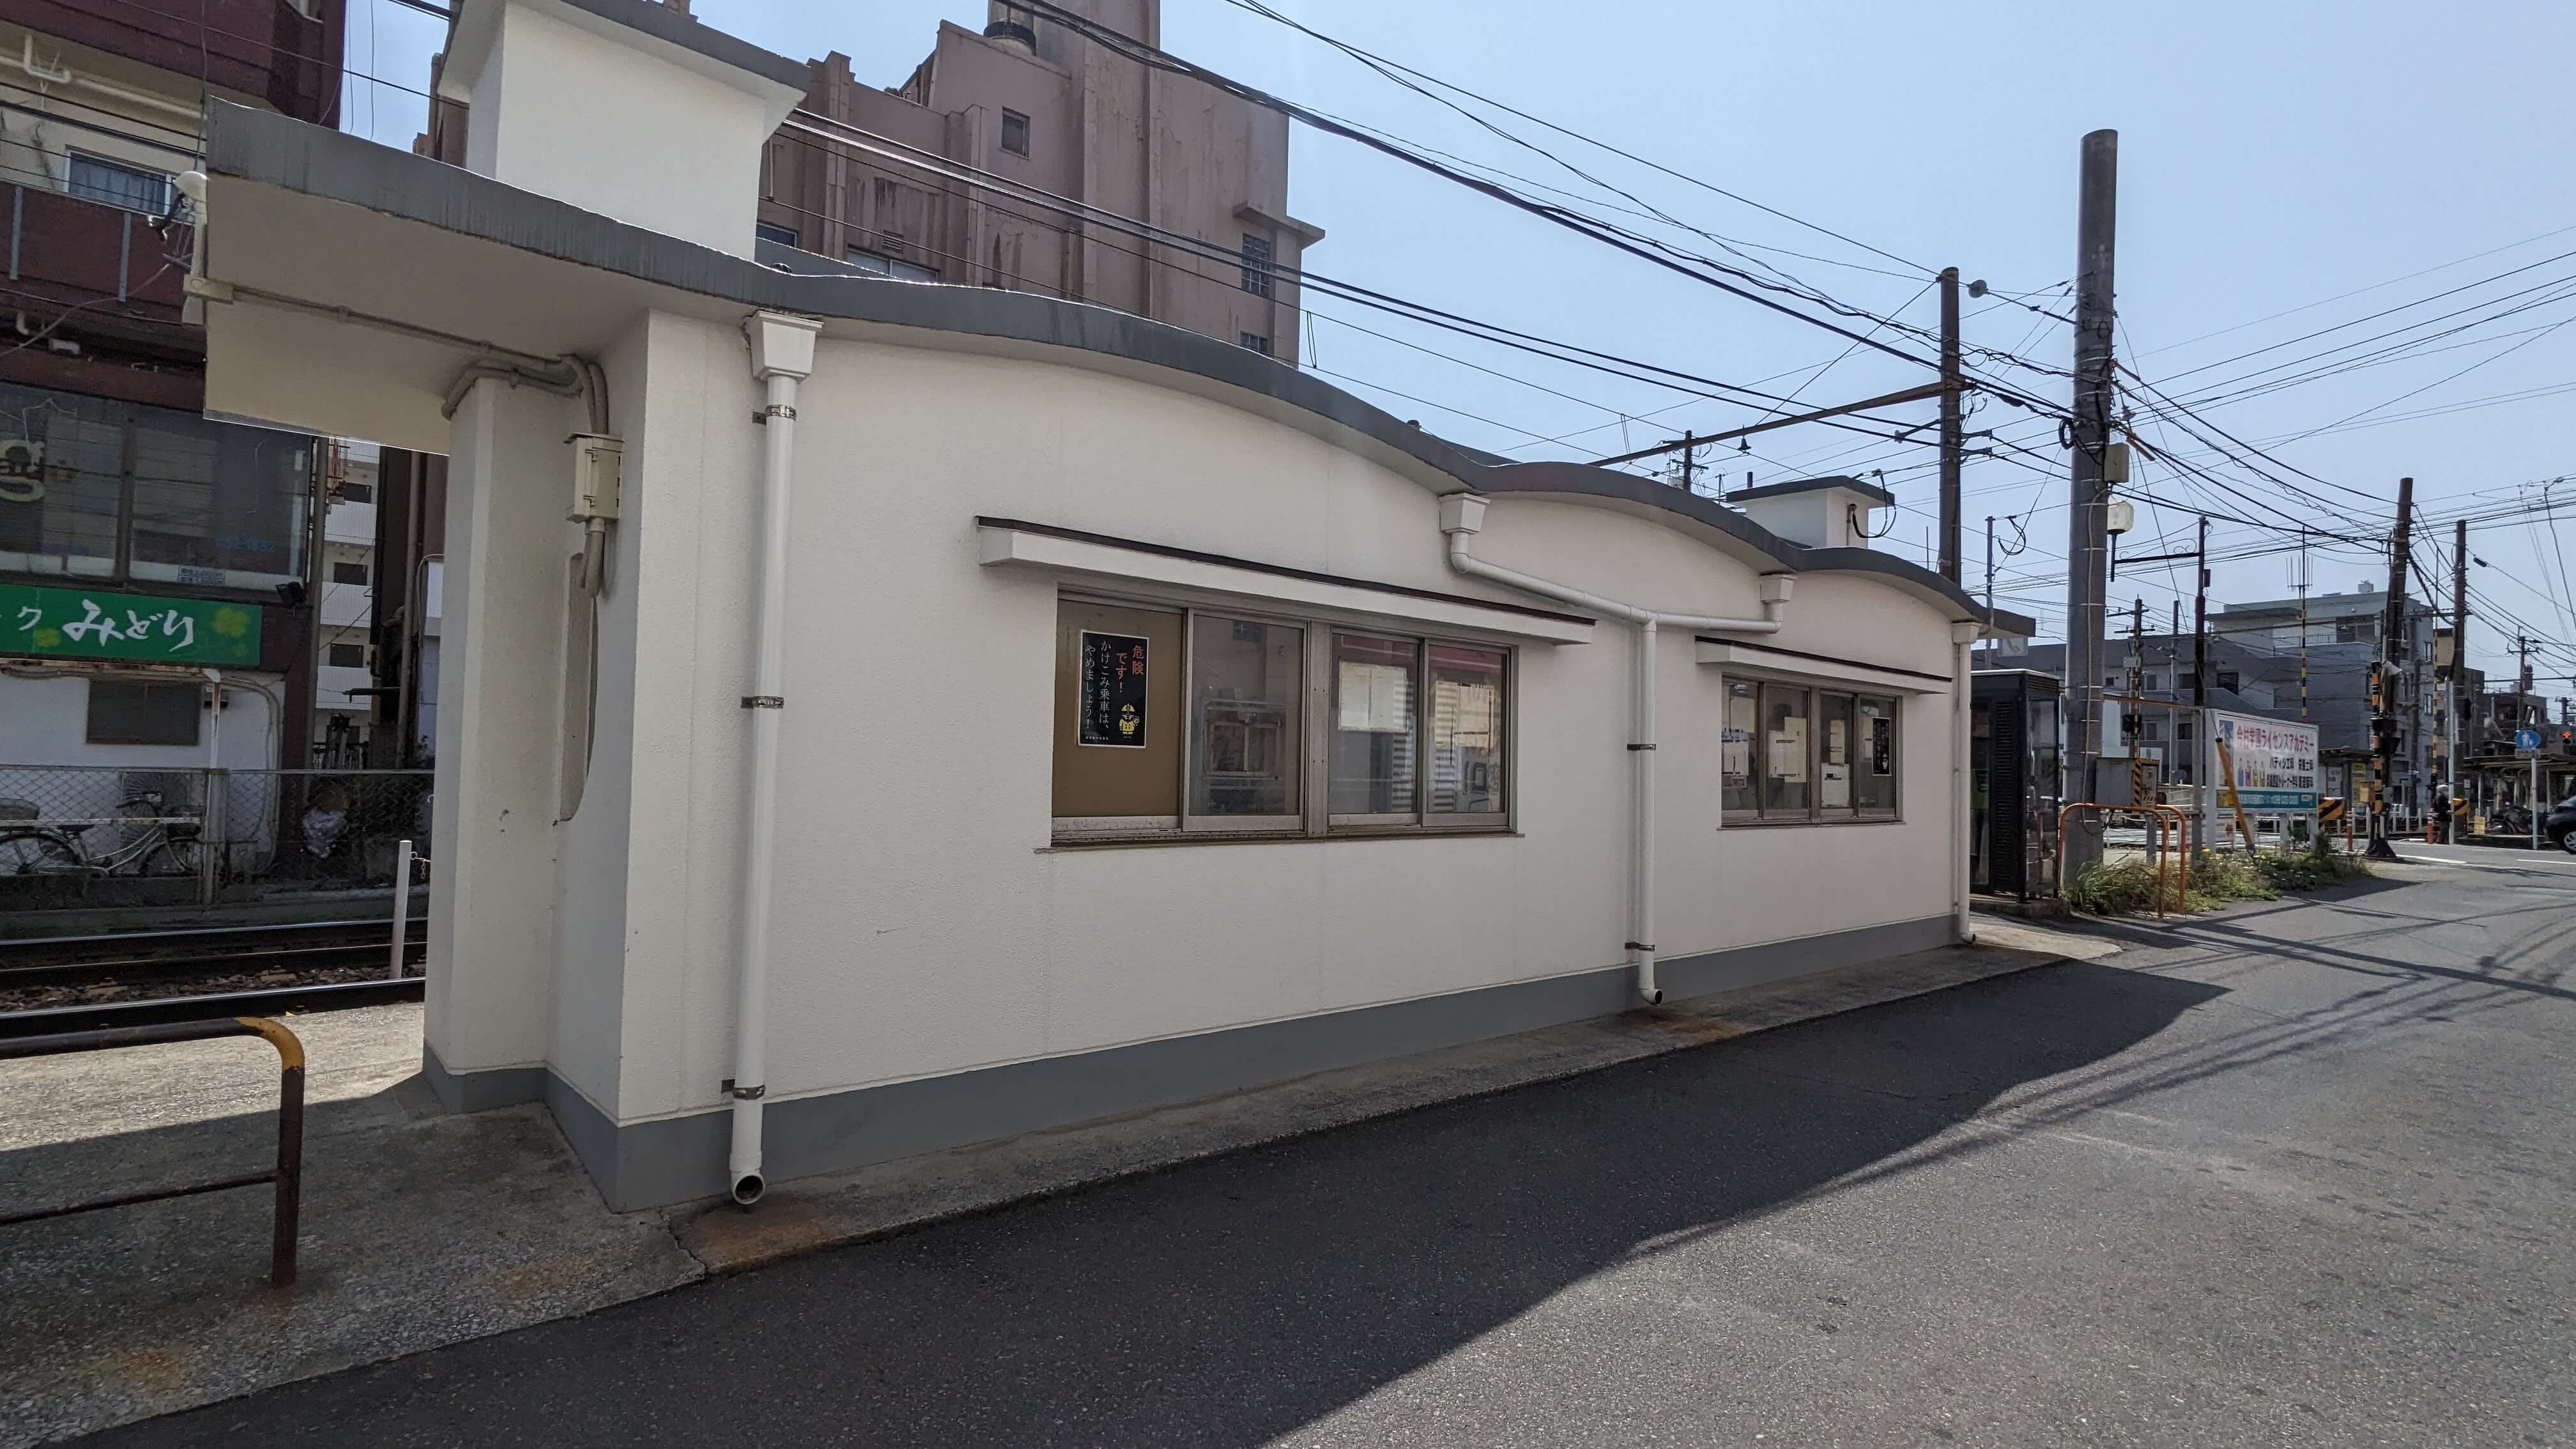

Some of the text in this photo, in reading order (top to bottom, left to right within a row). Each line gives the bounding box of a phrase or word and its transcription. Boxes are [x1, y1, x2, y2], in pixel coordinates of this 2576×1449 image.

[63, 599, 194, 652] みどり
[1085, 645, 1096, 728] やめましょう！
[1099, 641, 1111, 729] かけこみ乗車は、
[1116, 652, 1127, 693] です！
[1131, 645, 1144, 675] 危険
